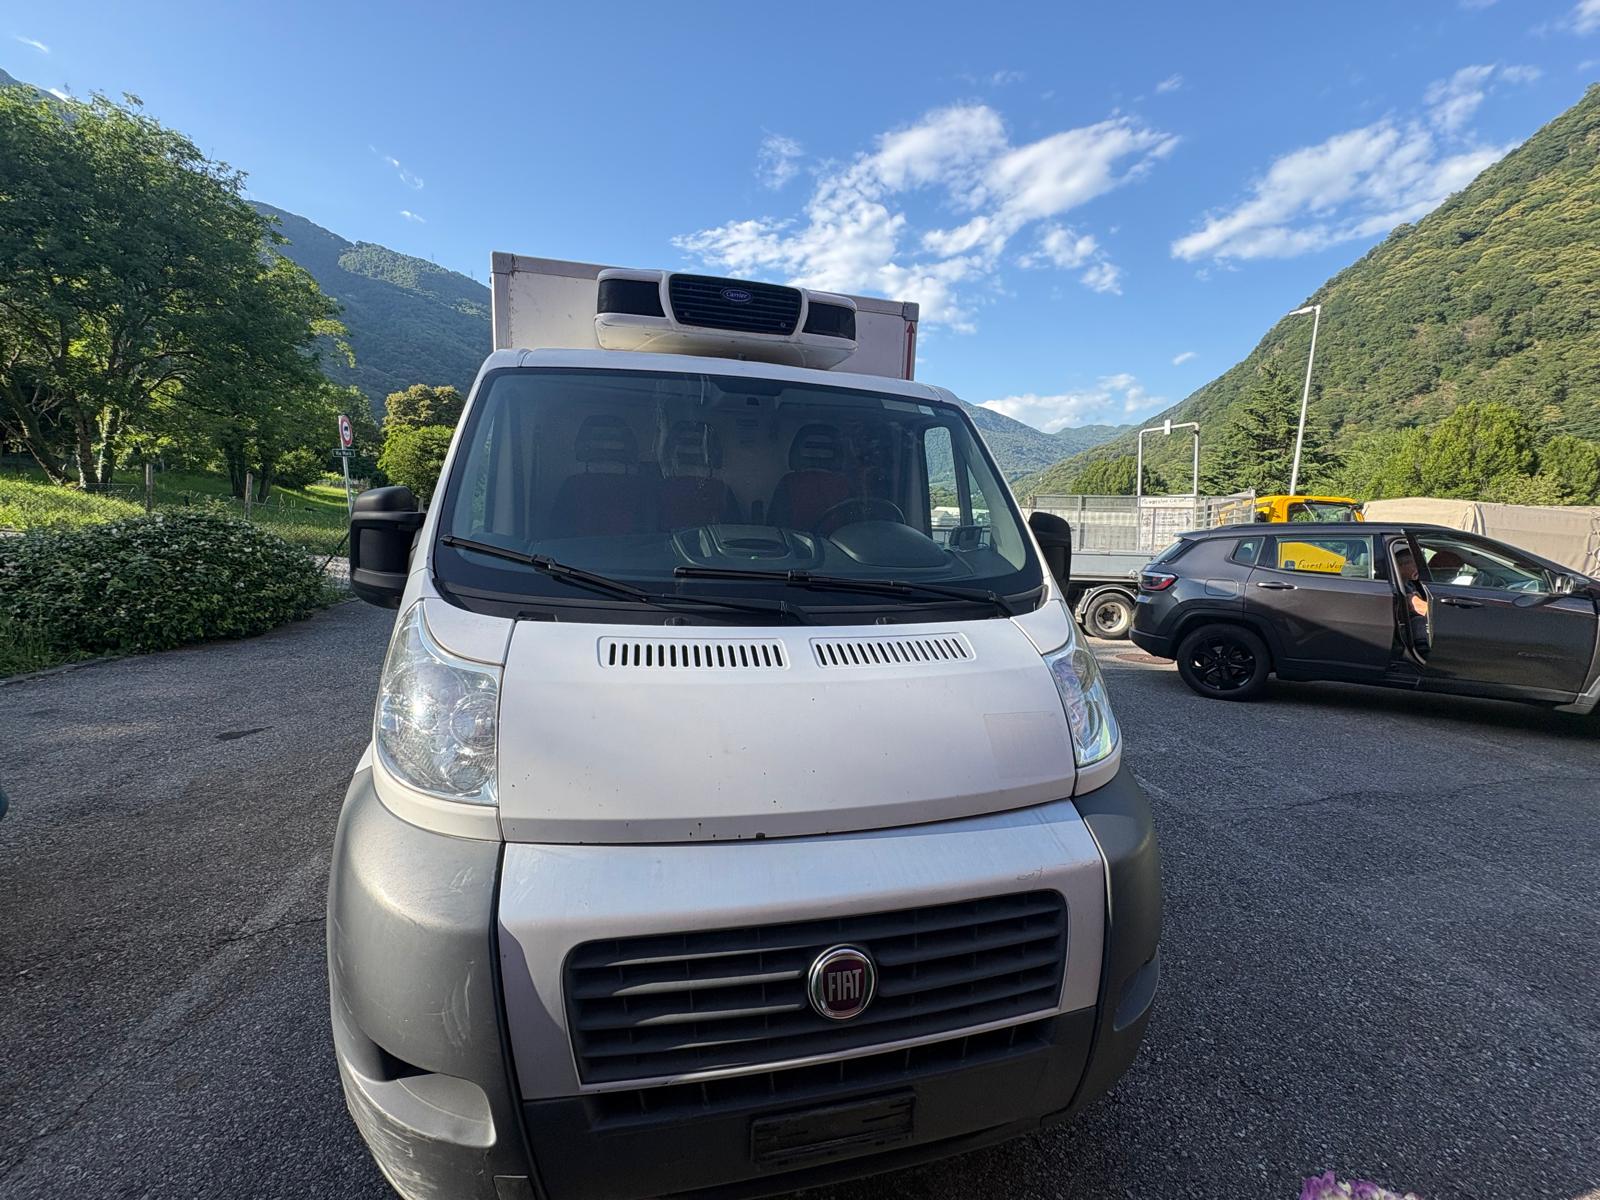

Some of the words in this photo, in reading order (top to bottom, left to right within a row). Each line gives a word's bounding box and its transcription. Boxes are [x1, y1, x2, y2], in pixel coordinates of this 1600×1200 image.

[1298, 559, 1322, 569] Forest
[1327, 561, 1343, 569] Wor
[828, 968, 862, 1002] FIAT
